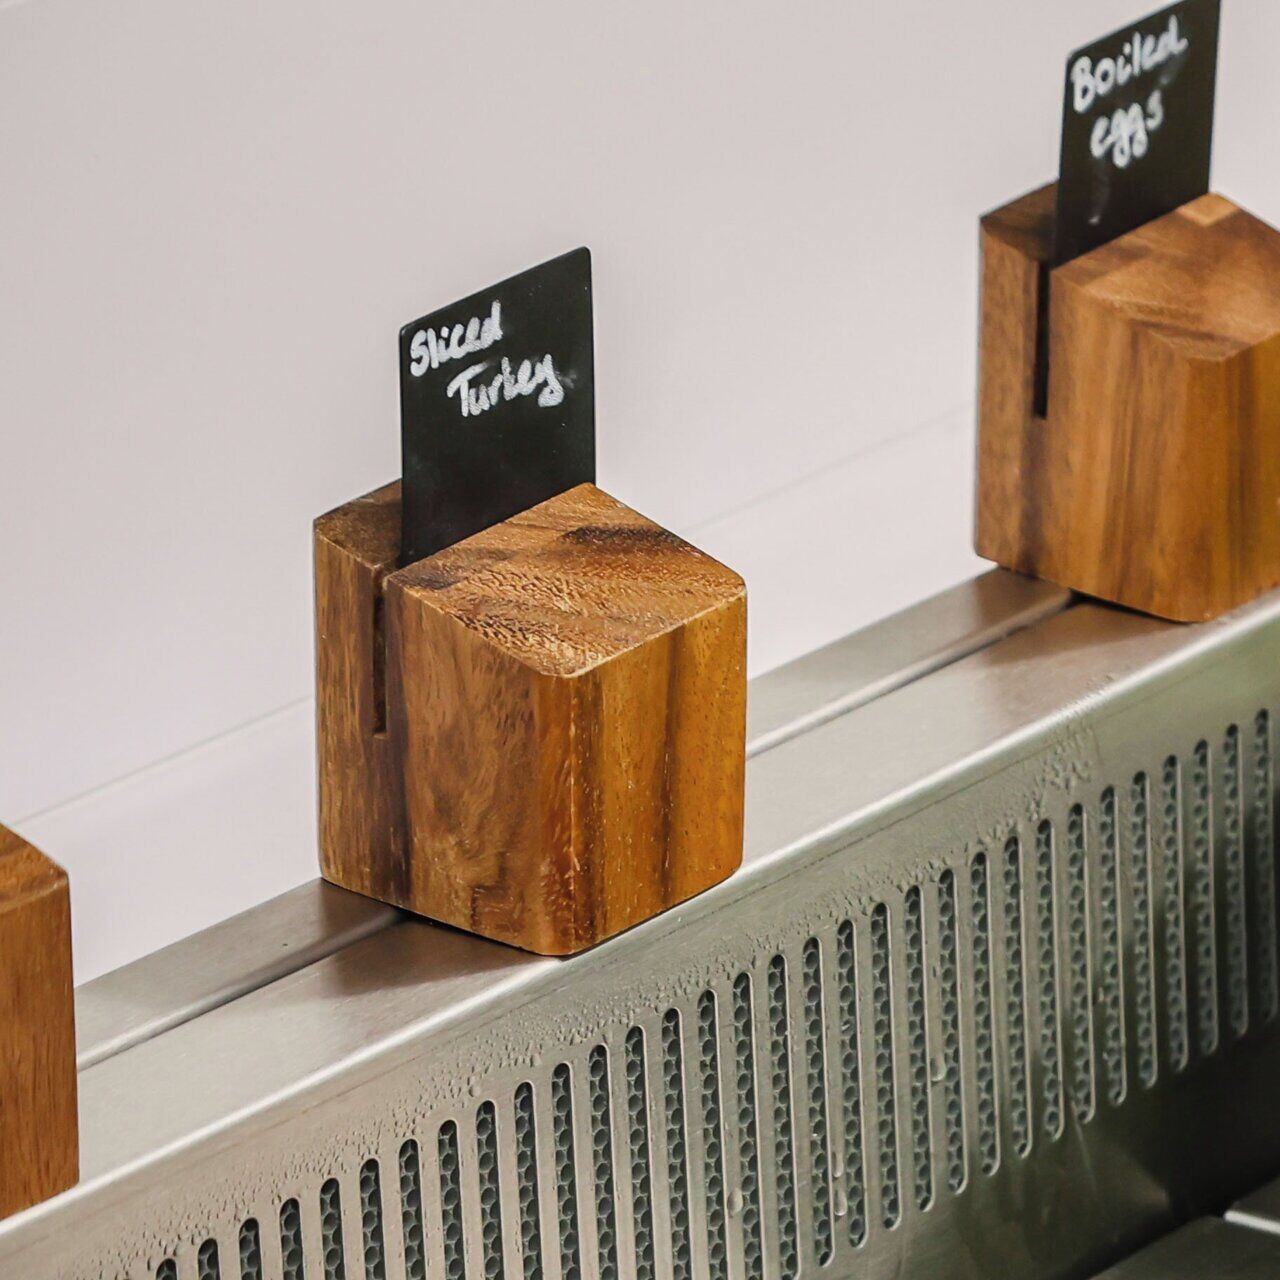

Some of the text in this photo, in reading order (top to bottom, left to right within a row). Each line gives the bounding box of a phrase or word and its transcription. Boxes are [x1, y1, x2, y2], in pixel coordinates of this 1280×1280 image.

[1071, 14, 1188, 113] Boiled
[1090, 89, 1163, 169] eggs
[410, 299, 503, 377] Sliced
[447, 353, 565, 417] Turkey
